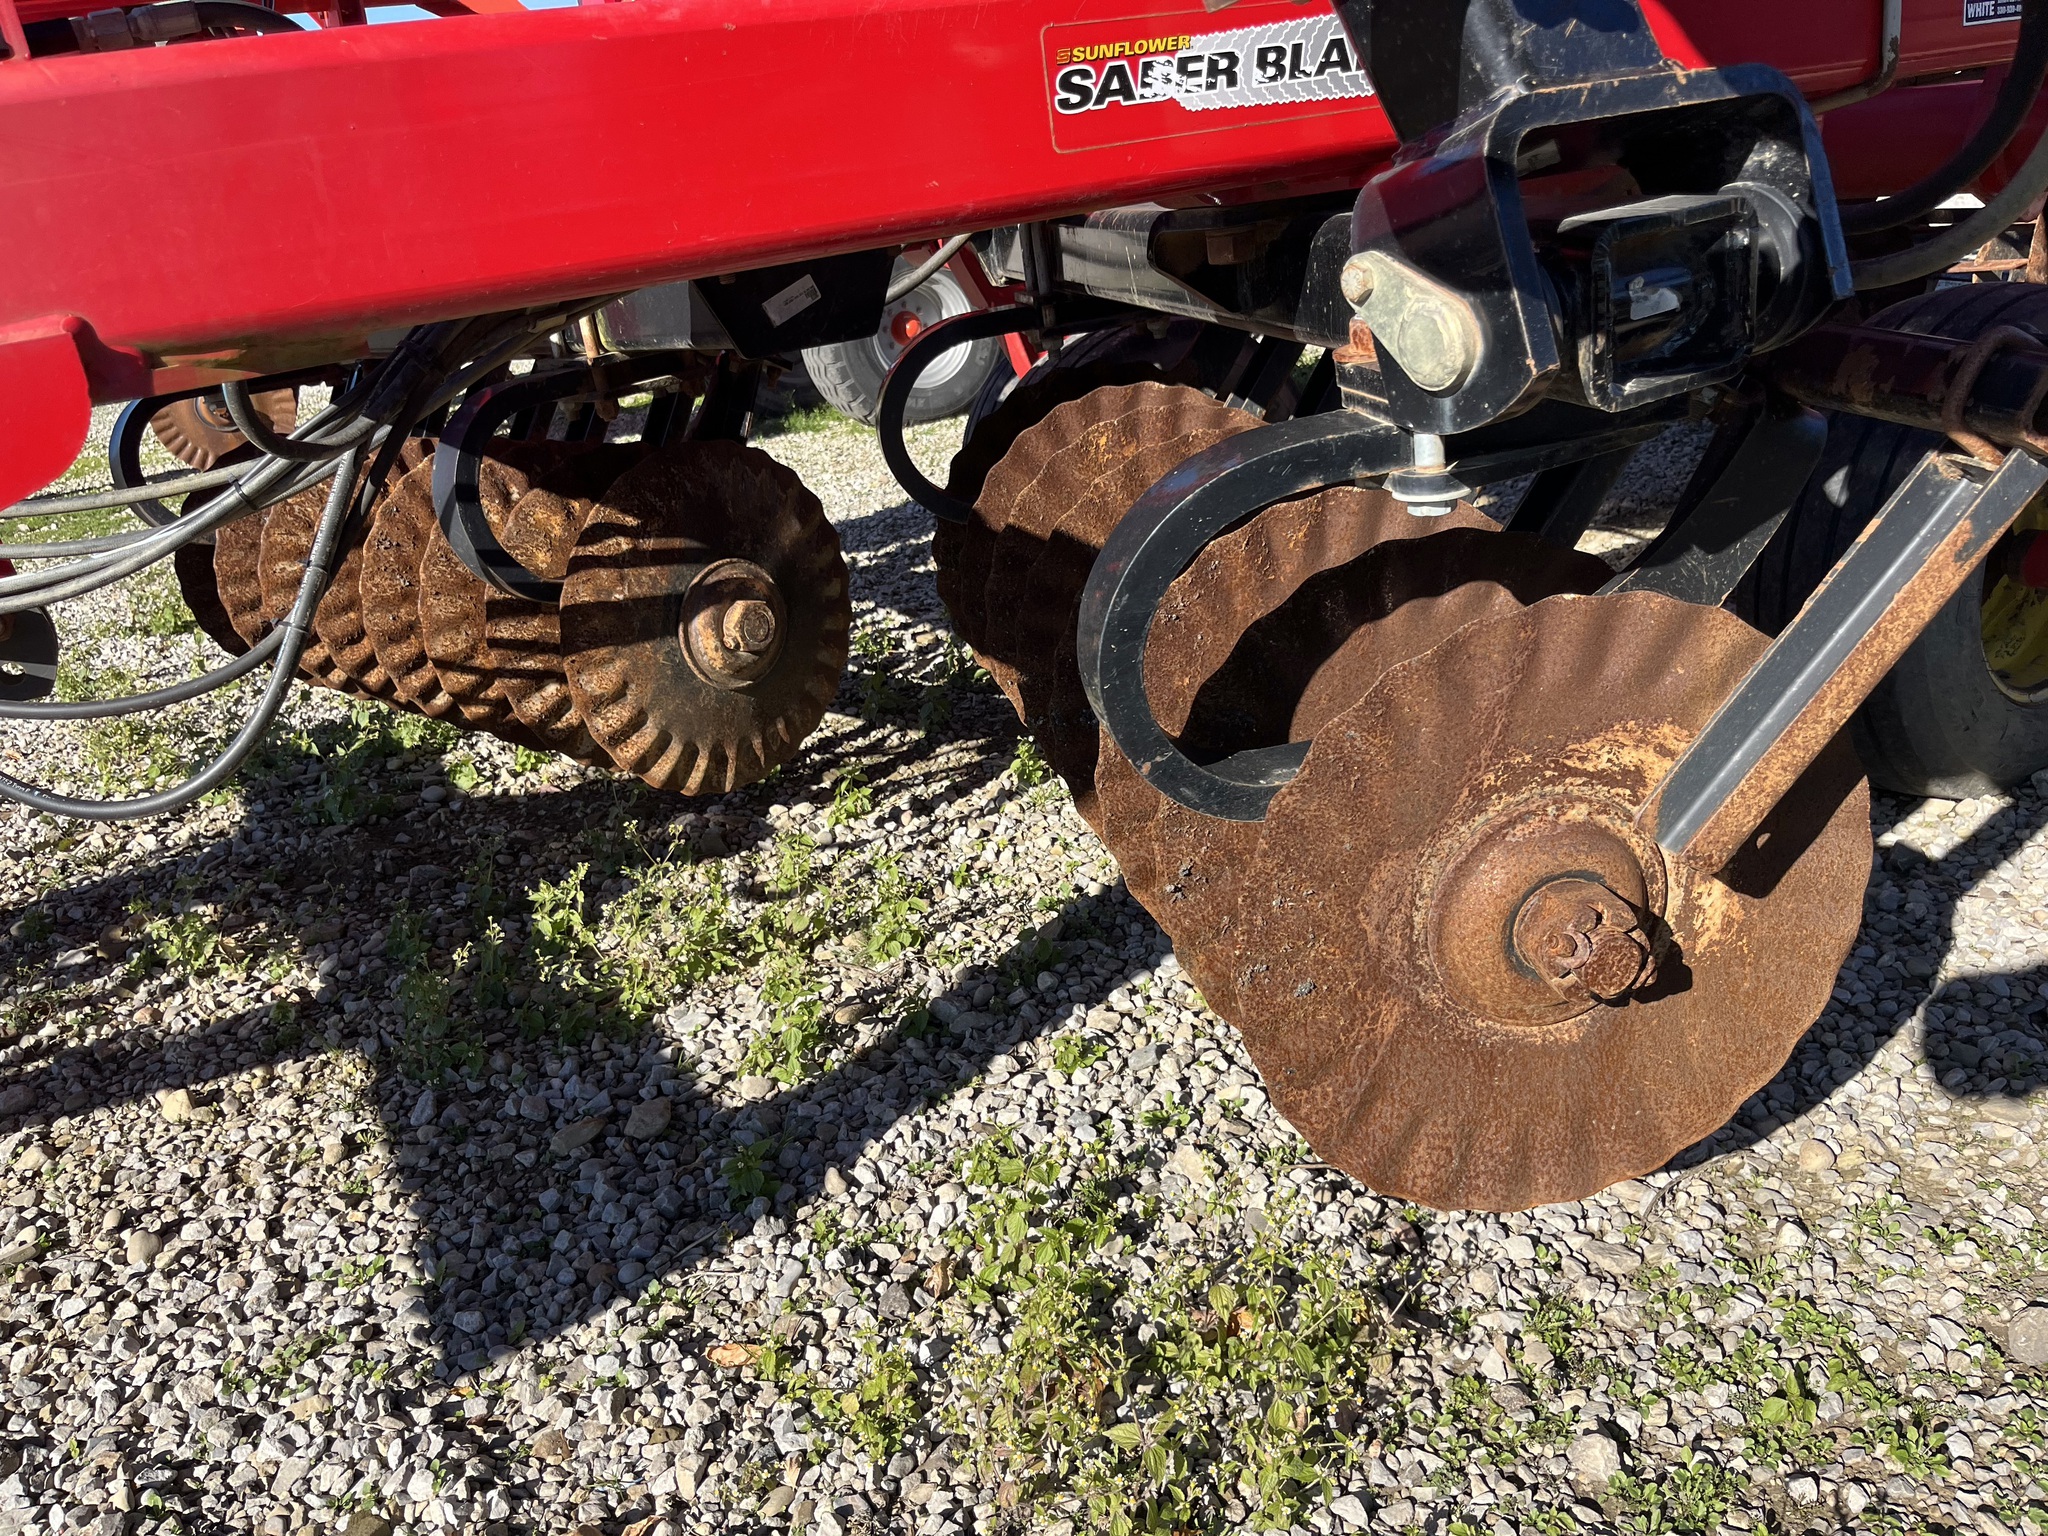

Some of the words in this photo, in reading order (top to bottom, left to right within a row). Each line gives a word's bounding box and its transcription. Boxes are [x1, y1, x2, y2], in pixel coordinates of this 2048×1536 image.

[1967, 1, 1995, 18] WHITE
[1072, 35, 1191, 62] SUNFLOWER
[1255, 36, 1364, 84] BLA
